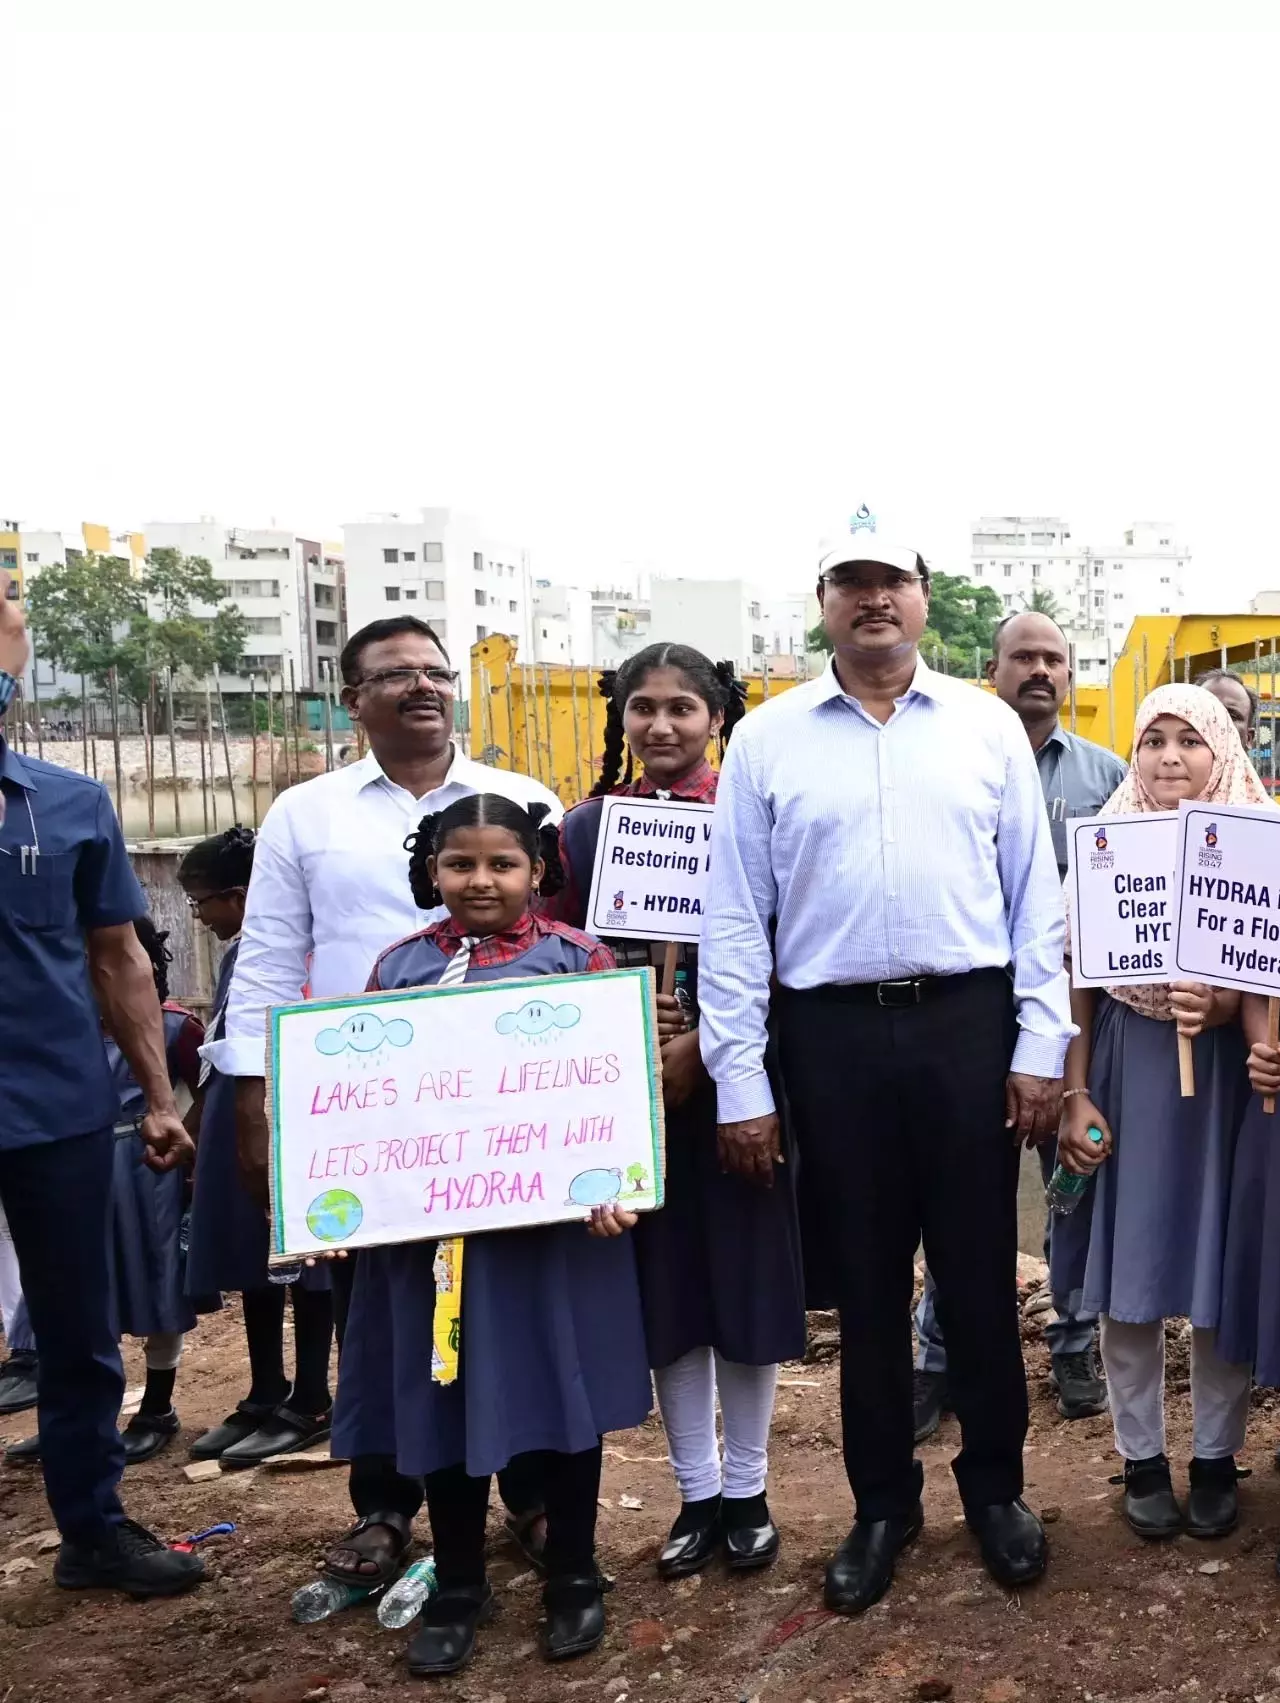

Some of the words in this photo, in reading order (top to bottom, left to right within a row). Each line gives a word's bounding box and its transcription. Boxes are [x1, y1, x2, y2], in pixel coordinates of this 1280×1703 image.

[617, 816, 696, 843] Reviving
[611, 846, 698, 875] Restoring
[1198, 851, 1223, 861] RISING
[1198, 859, 1222, 868] 2047
[1114, 874, 1166, 894] Clean
[1189, 874, 1270, 908] HYDRAA
[644, 894, 705, 915] HYDRA
[1118, 899, 1167, 919] Clear
[1197, 908, 1227, 932] For
[1234, 917, 1244, 935] a
[1108, 949, 1163, 970] Leads
[310, 1077, 399, 1115] LAKES
[414, 1068, 472, 1102] ARE
[497, 1053, 621, 1095] LIFELINES
[308, 1144, 368, 1180] LETS
[373, 1130, 470, 1172] PROTECT
[483, 1123, 547, 1157] THEM
[563, 1115, 614, 1147] WITH
[423, 1171, 546, 1214] HYDRAA
